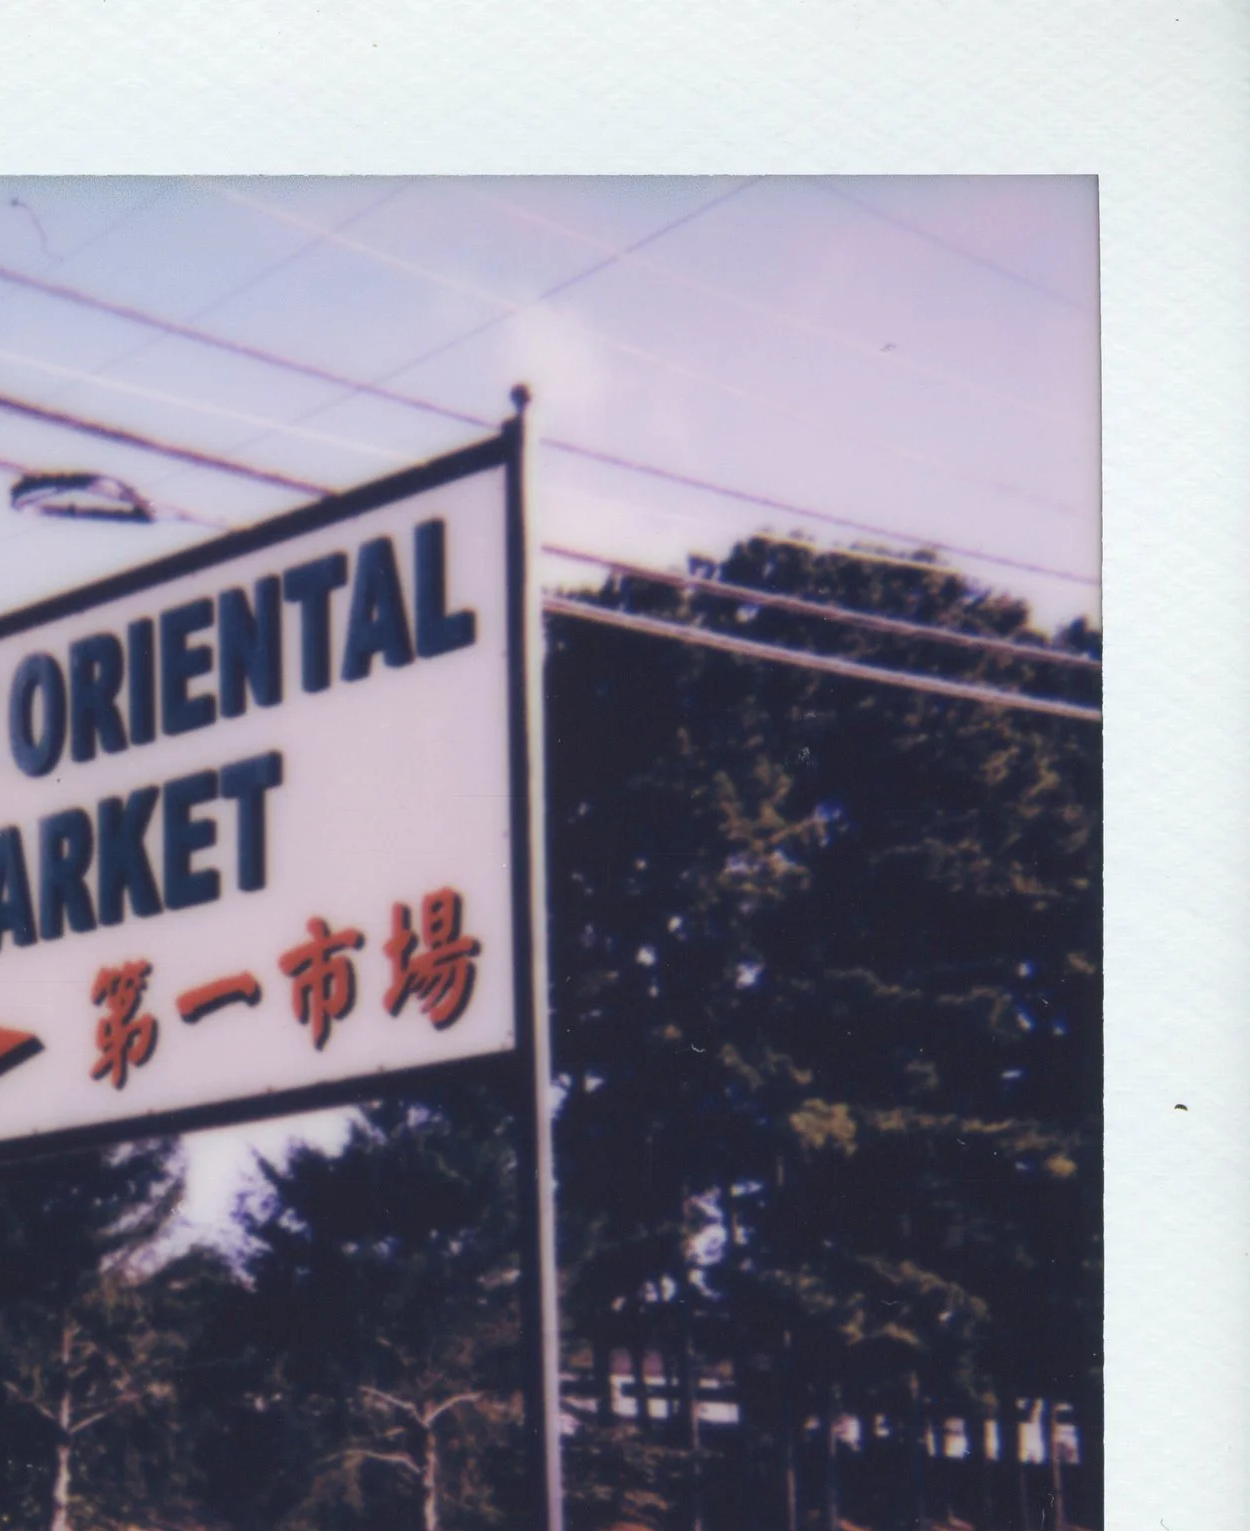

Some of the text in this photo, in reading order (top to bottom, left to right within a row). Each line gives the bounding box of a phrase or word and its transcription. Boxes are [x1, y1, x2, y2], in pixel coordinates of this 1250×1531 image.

[8, 516, 478, 778] ORIENTAL
[89, 886, 481, 1090] 第一市場
